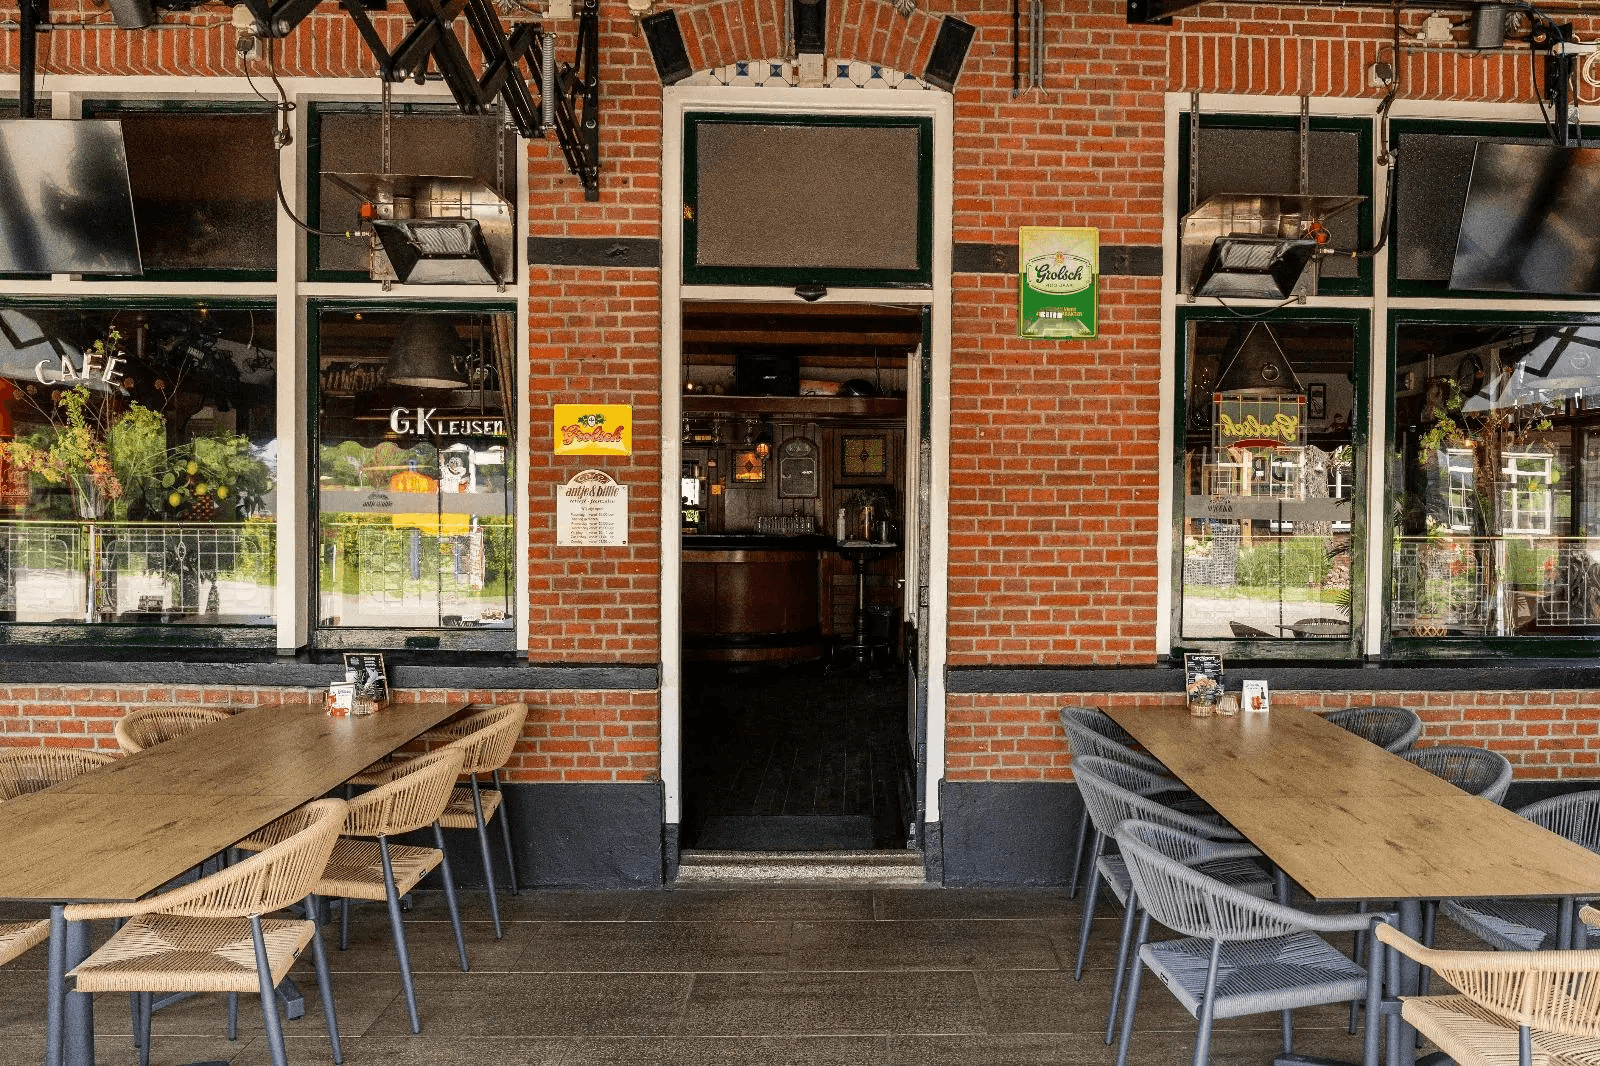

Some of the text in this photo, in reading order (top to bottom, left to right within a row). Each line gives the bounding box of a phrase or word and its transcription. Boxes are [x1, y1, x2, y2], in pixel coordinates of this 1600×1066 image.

[1035, 264, 1083, 283] Grolsch
[35, 350, 127, 387] CAFÉ
[560, 424, 625, 445] Grolsch
